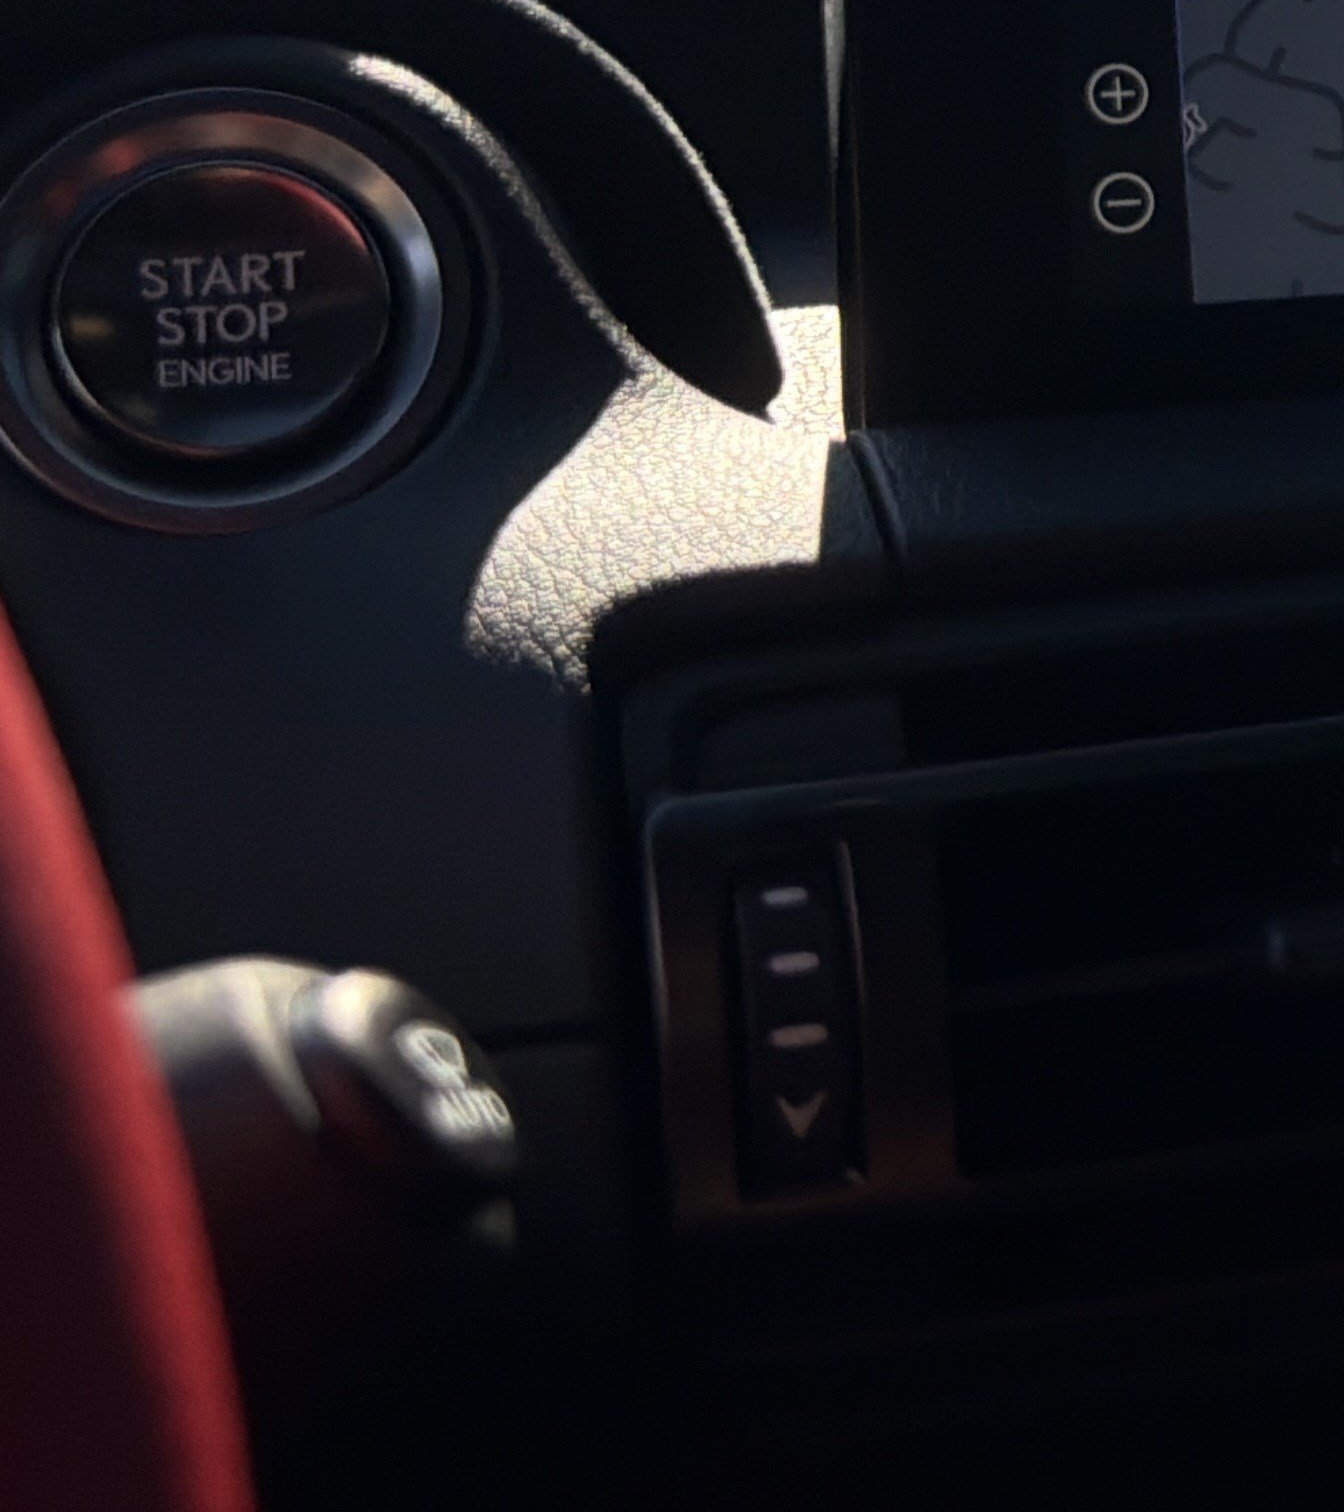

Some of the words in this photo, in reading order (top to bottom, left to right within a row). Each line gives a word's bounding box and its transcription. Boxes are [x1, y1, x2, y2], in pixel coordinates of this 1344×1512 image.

[139, 250, 306, 299] START
[156, 302, 288, 346] STOP
[158, 352, 292, 388] ENGINE
